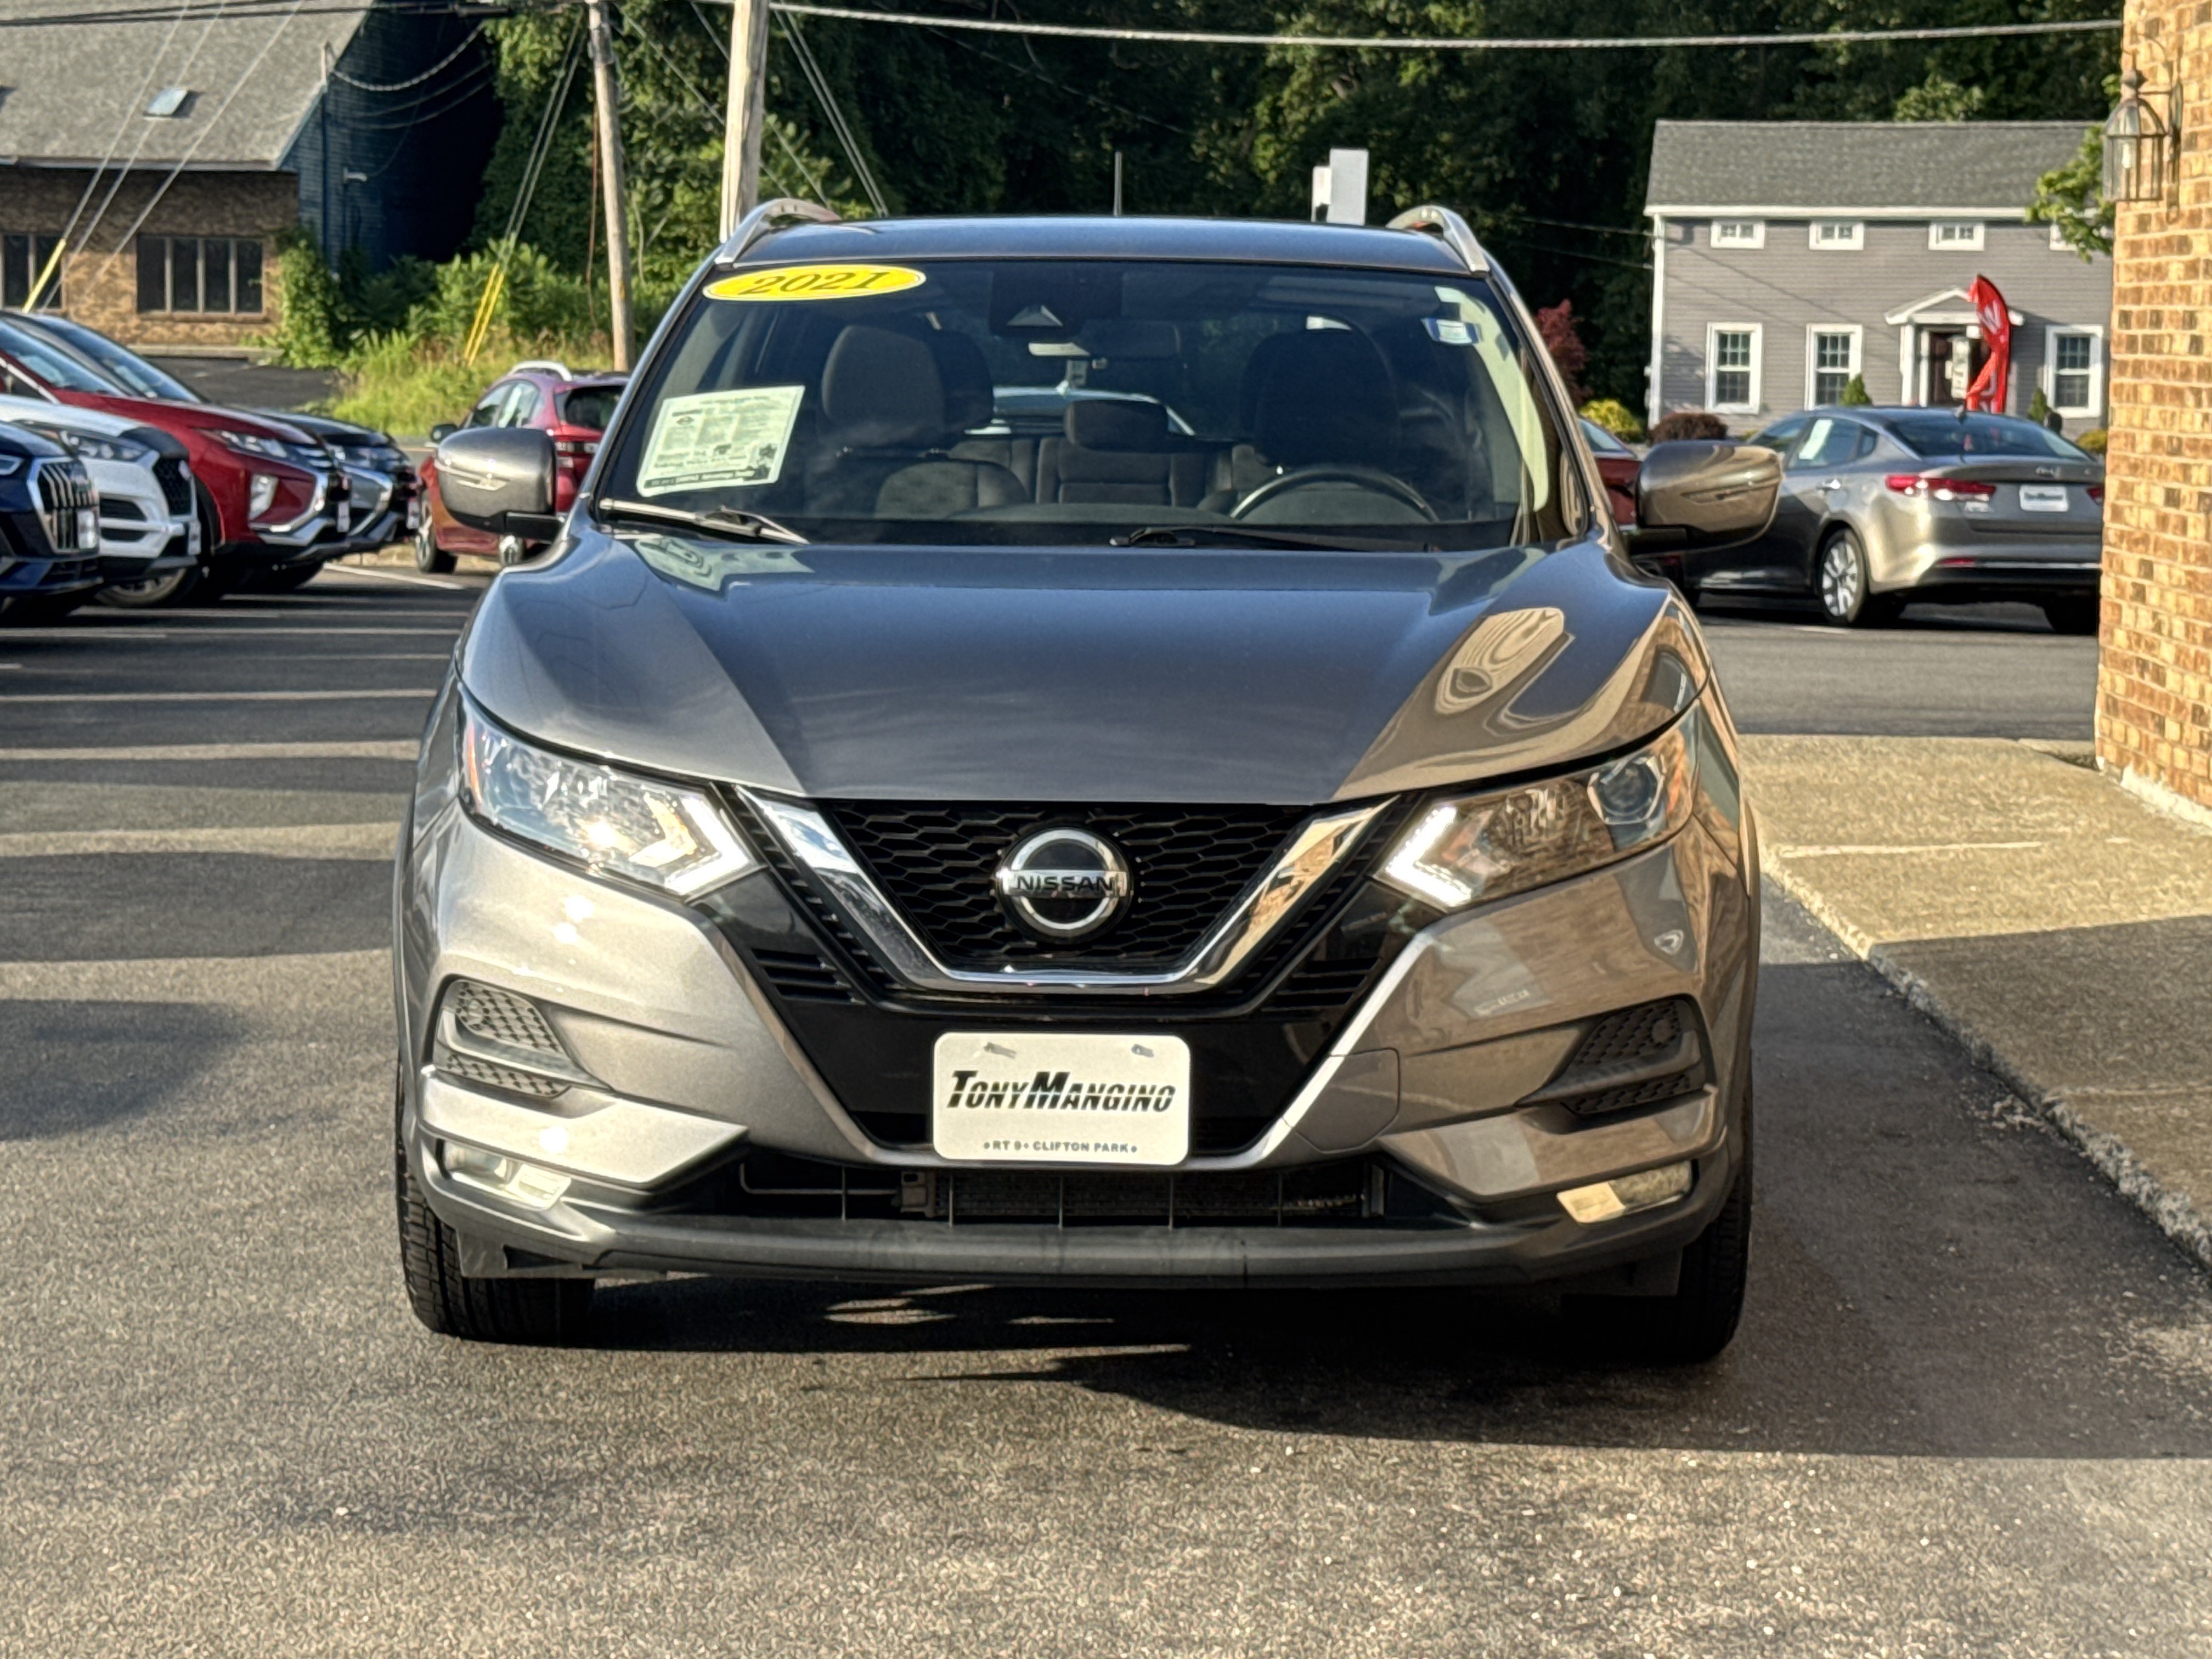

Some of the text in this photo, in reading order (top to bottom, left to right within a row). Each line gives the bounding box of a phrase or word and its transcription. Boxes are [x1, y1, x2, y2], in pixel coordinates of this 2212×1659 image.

[738, 272, 889, 295] 2021
[1017, 876, 1114, 891] NISSAN
[992, 1139, 1011, 1151] RT
[1032, 1141, 1090, 1152] CLIFTON
[1094, 1143, 1128, 1153] PARK
